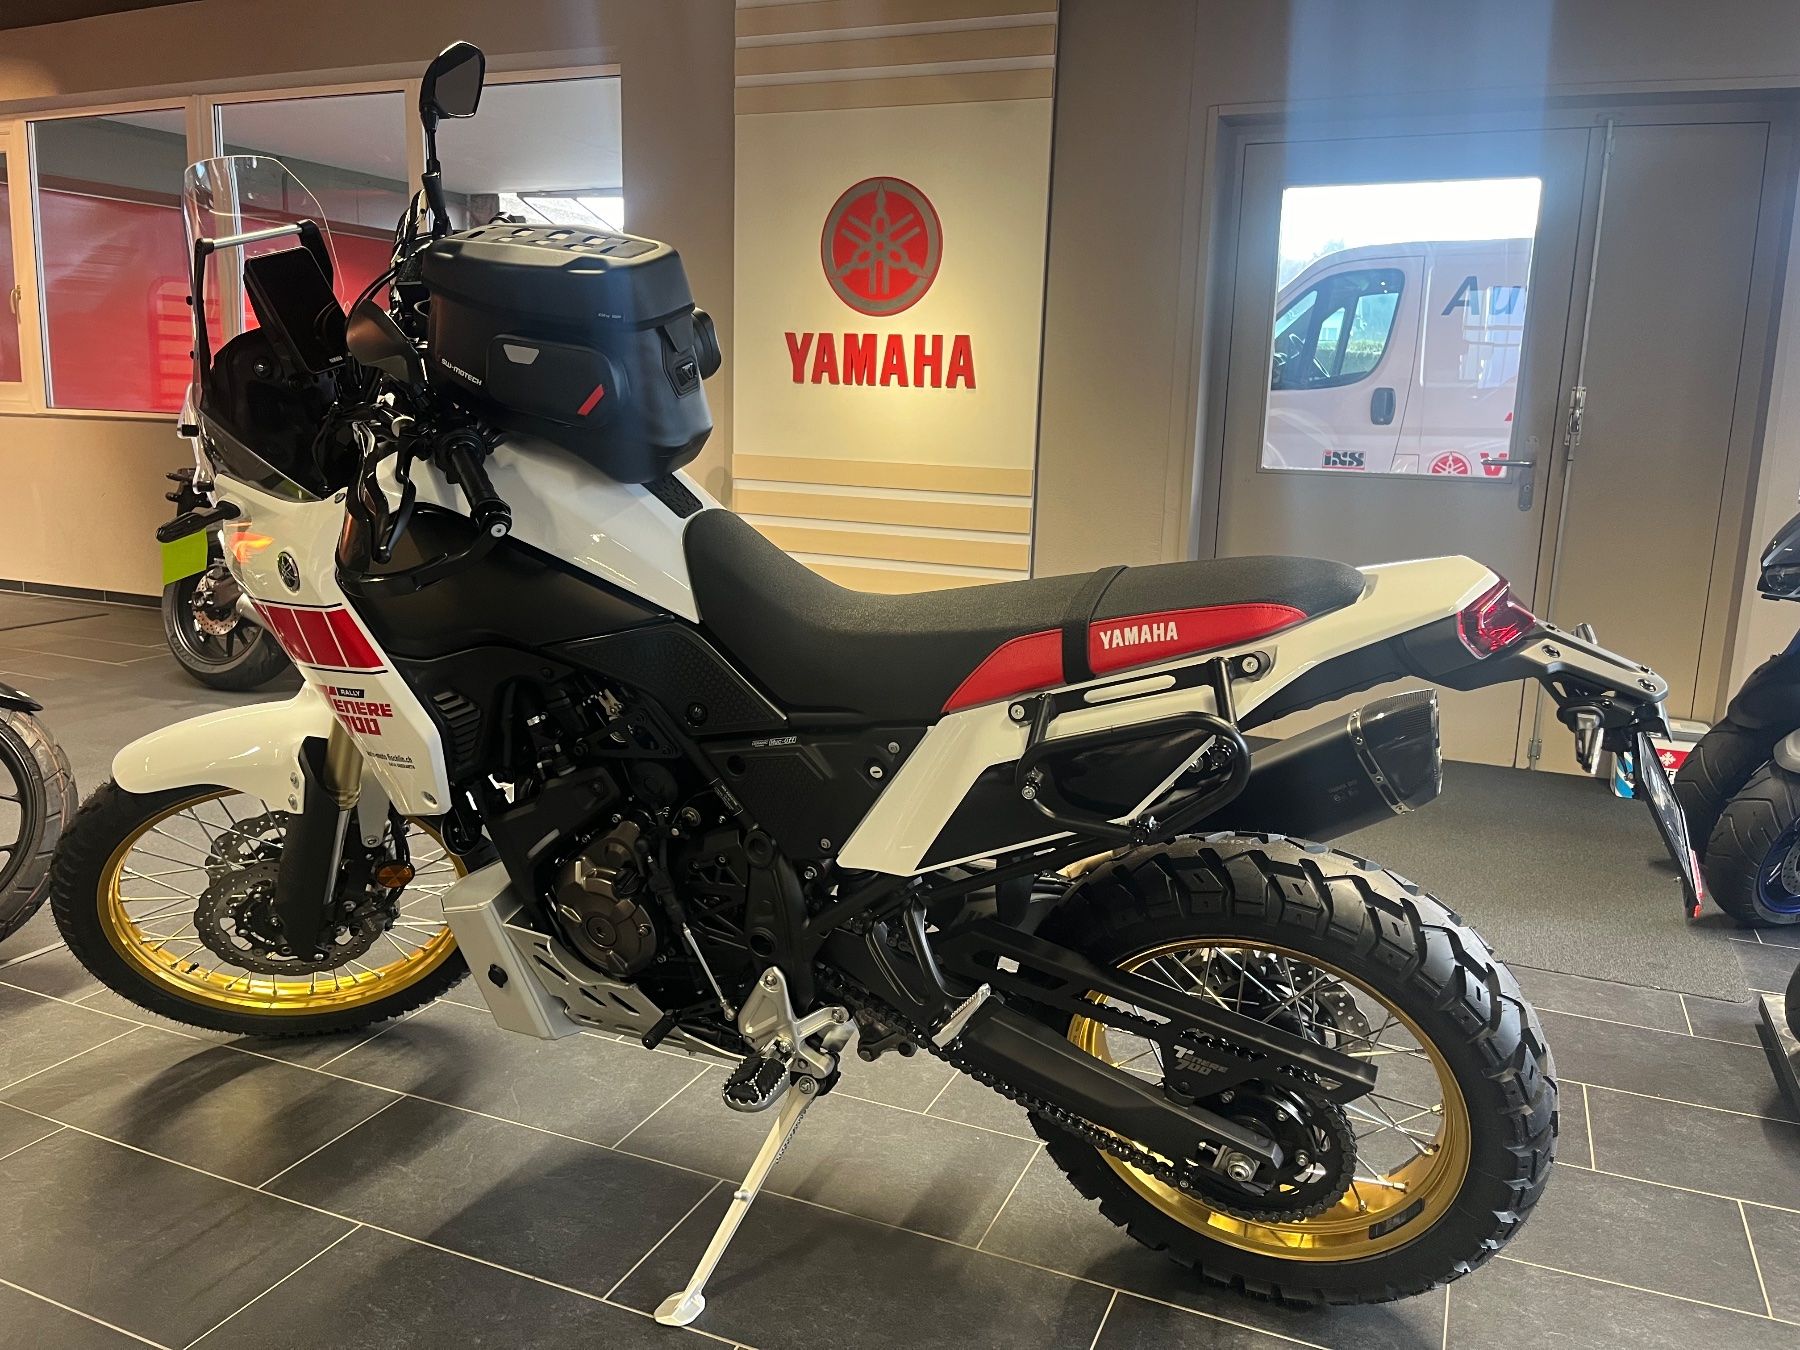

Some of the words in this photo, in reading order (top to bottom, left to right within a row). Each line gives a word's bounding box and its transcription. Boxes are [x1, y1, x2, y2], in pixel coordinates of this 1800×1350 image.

[1441, 275, 1527, 316] Au
[785, 332, 976, 389] YAMAHA
[1099, 621, 1178, 650] YAMAHA
[340, 688, 361, 698] RALLY
[1174, 1058, 1212, 1076] 700
